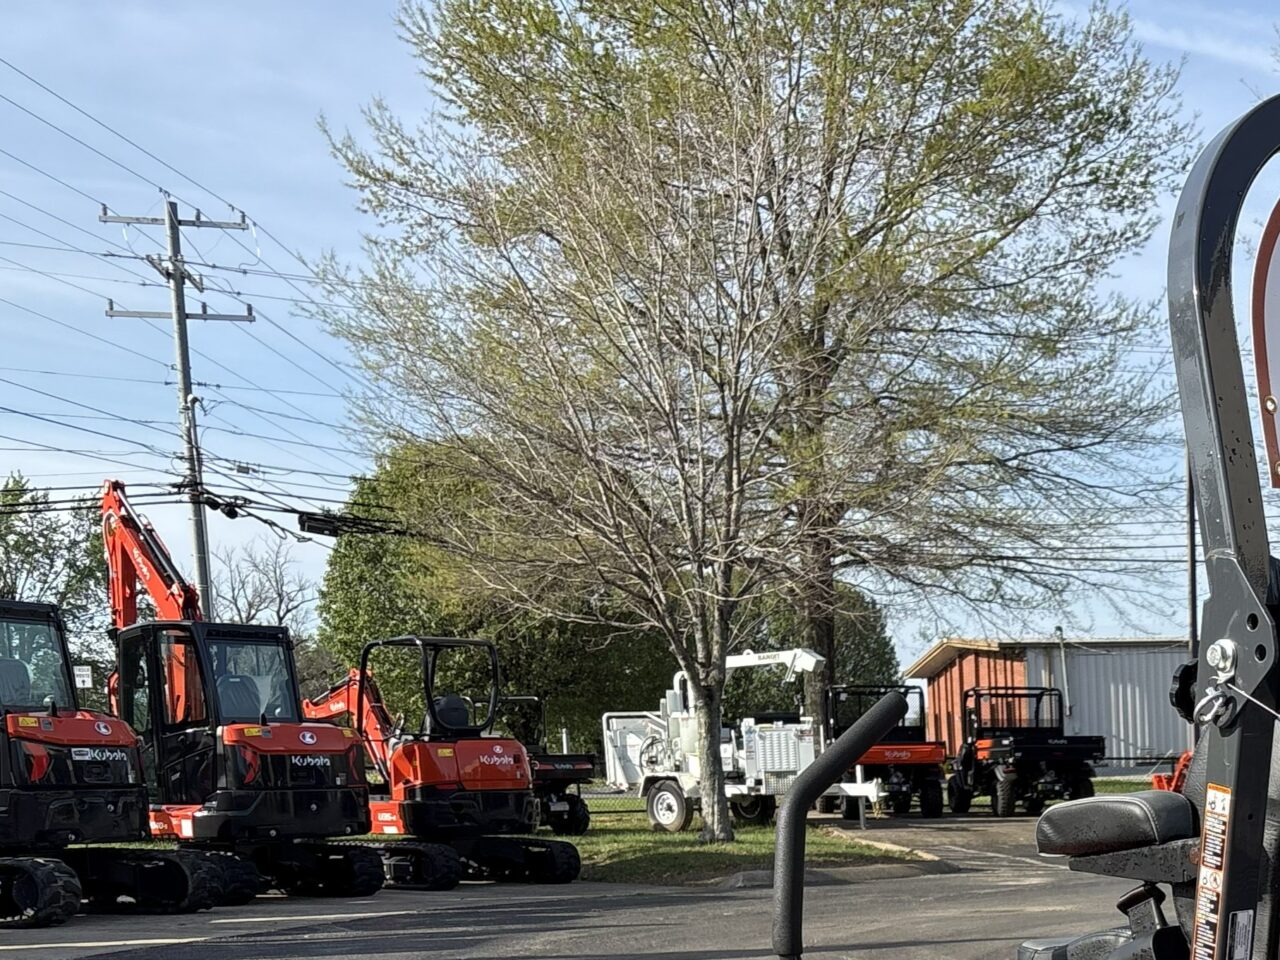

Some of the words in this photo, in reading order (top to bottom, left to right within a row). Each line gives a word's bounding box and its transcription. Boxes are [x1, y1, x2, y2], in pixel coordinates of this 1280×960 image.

[90, 749, 127, 761] Kubota
[291, 755, 331, 767] Kubota
[480, 754, 514, 765] Kubota
